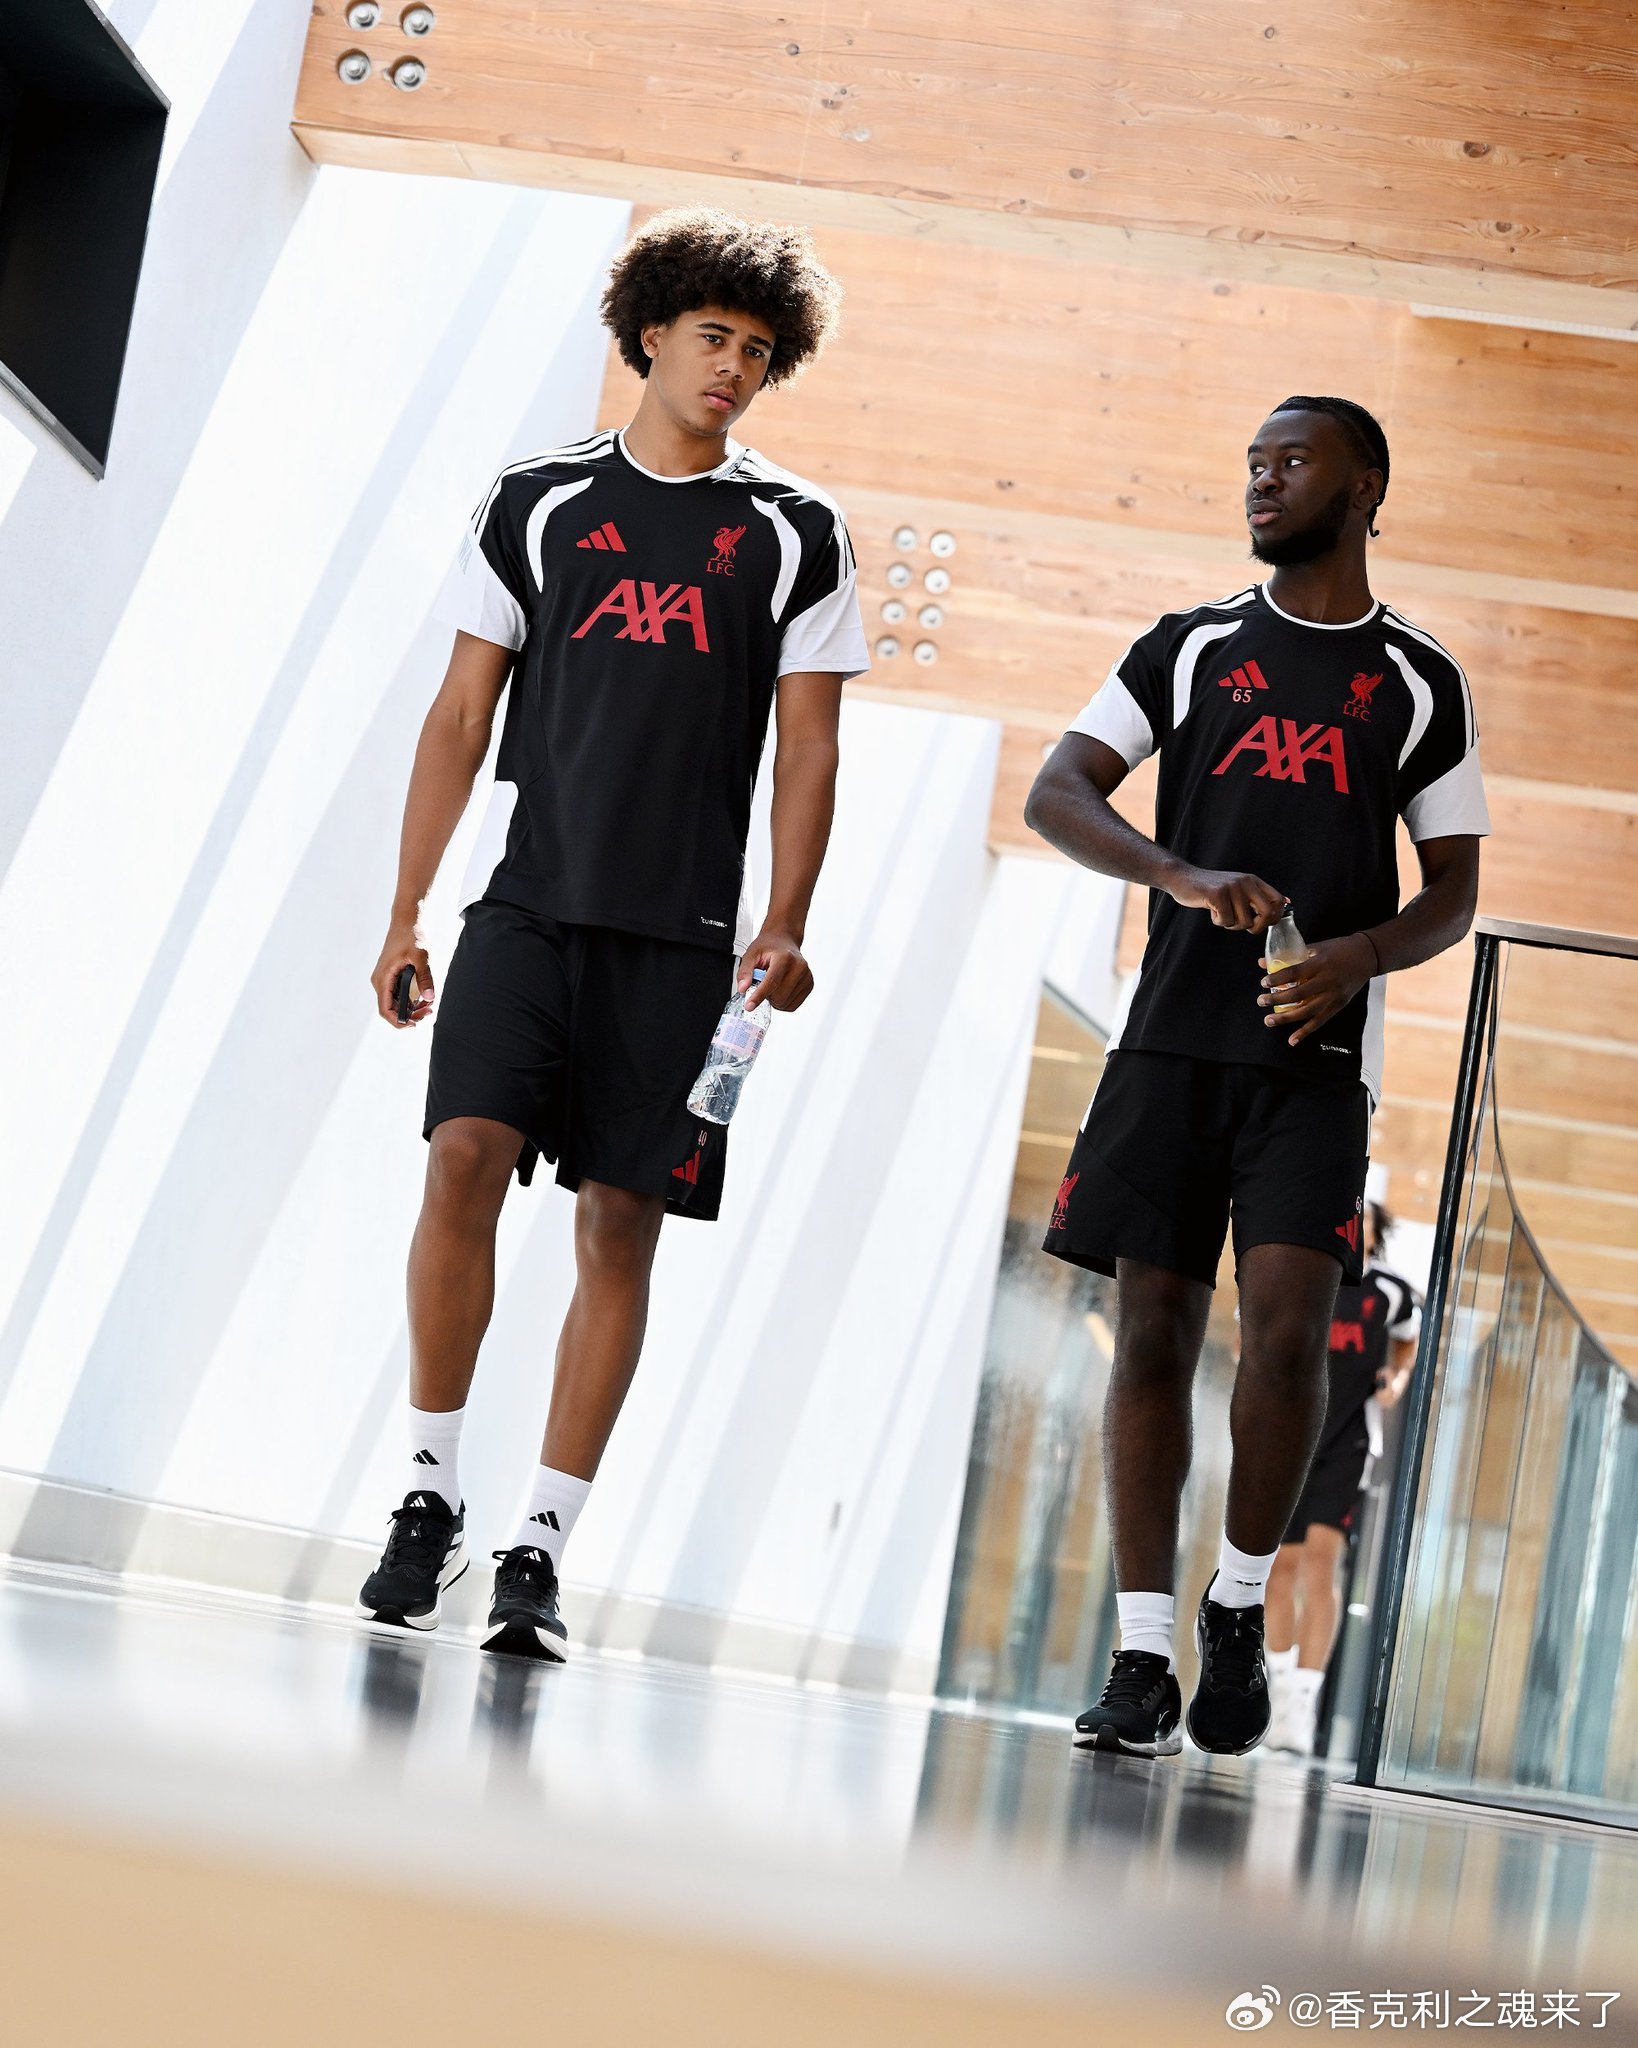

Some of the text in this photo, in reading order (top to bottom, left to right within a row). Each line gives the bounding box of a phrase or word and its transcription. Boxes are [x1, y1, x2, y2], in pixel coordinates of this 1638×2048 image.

[571, 578, 711, 653] AXA
[1232, 688, 1253, 704] 65
[1211, 714, 1350, 795] AXA
